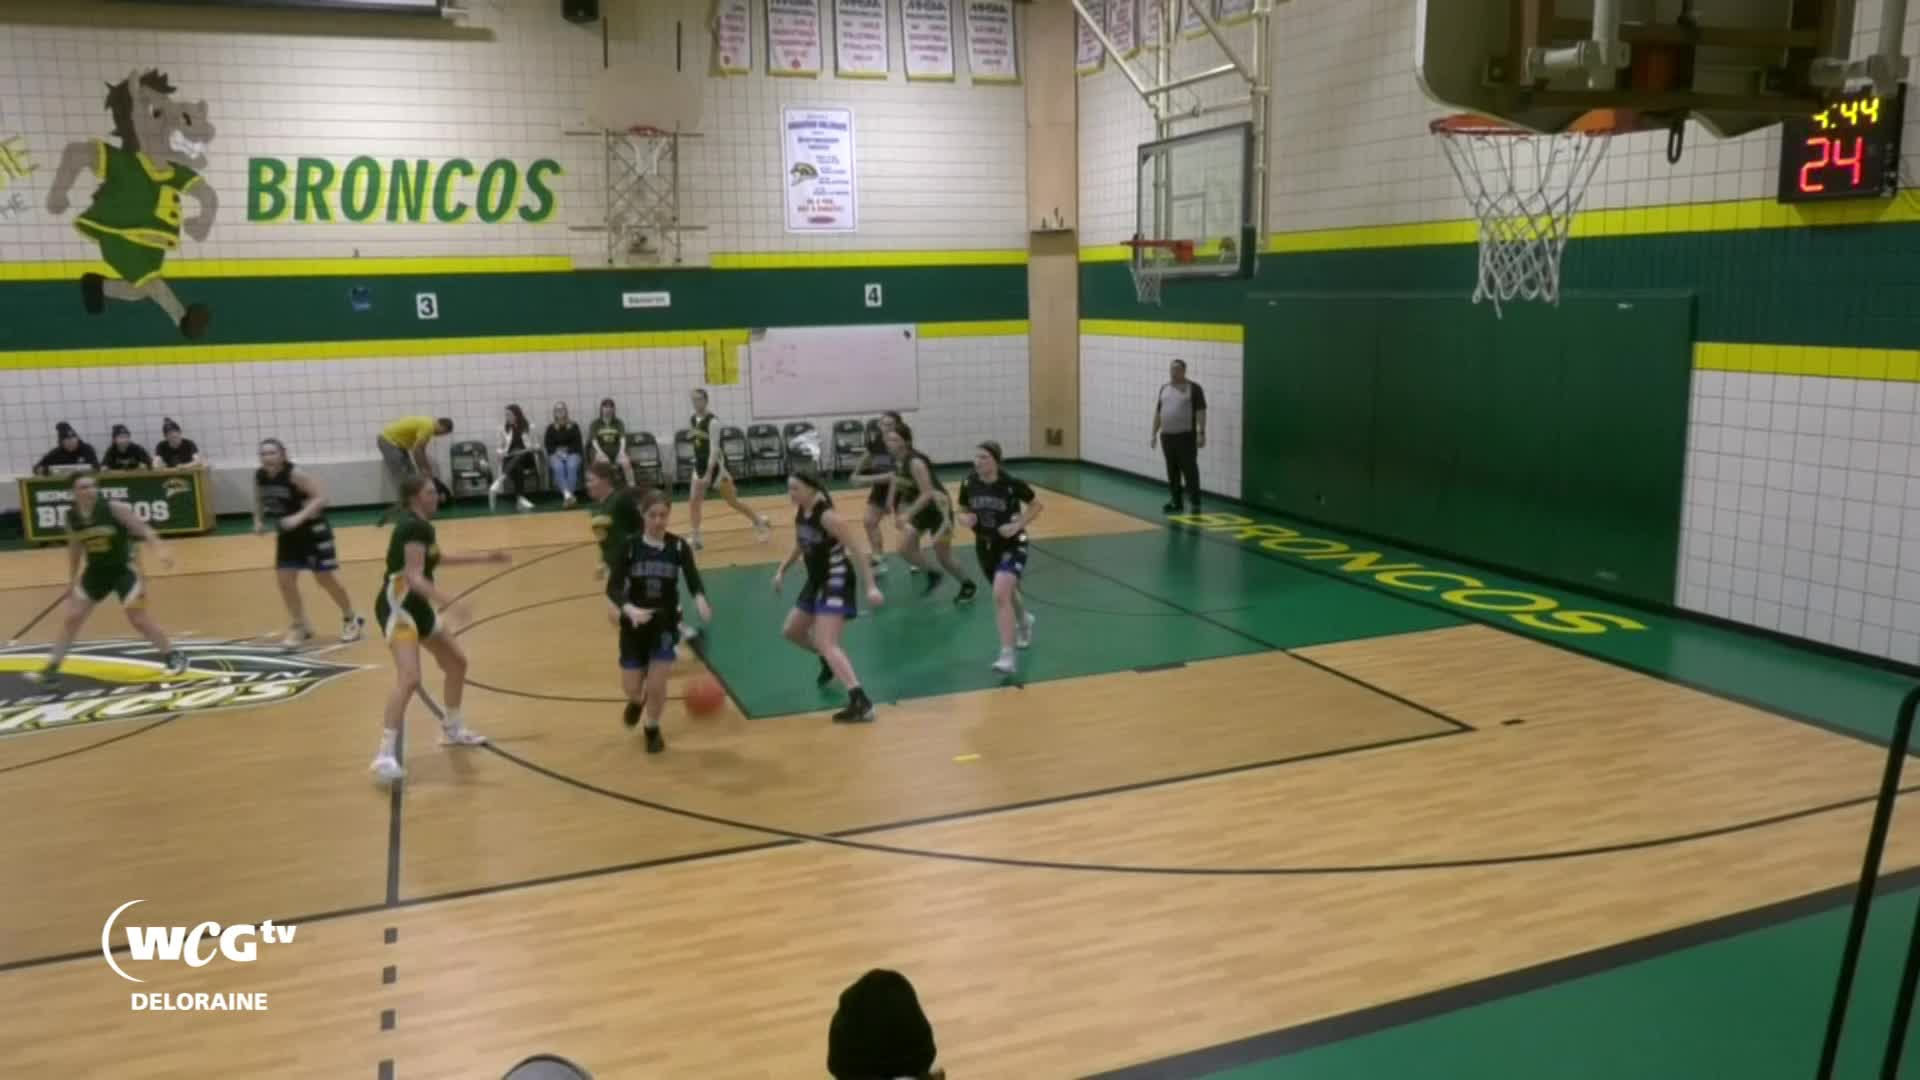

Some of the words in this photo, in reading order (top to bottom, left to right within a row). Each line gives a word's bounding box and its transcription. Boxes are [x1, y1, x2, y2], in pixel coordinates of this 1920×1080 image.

[247, 155, 564, 225] BRONCOS
[1800, 136, 1862, 192] 24
[420, 296, 434, 317] 3
[868, 287, 879, 304] 4
[1167, 512, 1648, 634] BRONCOS
